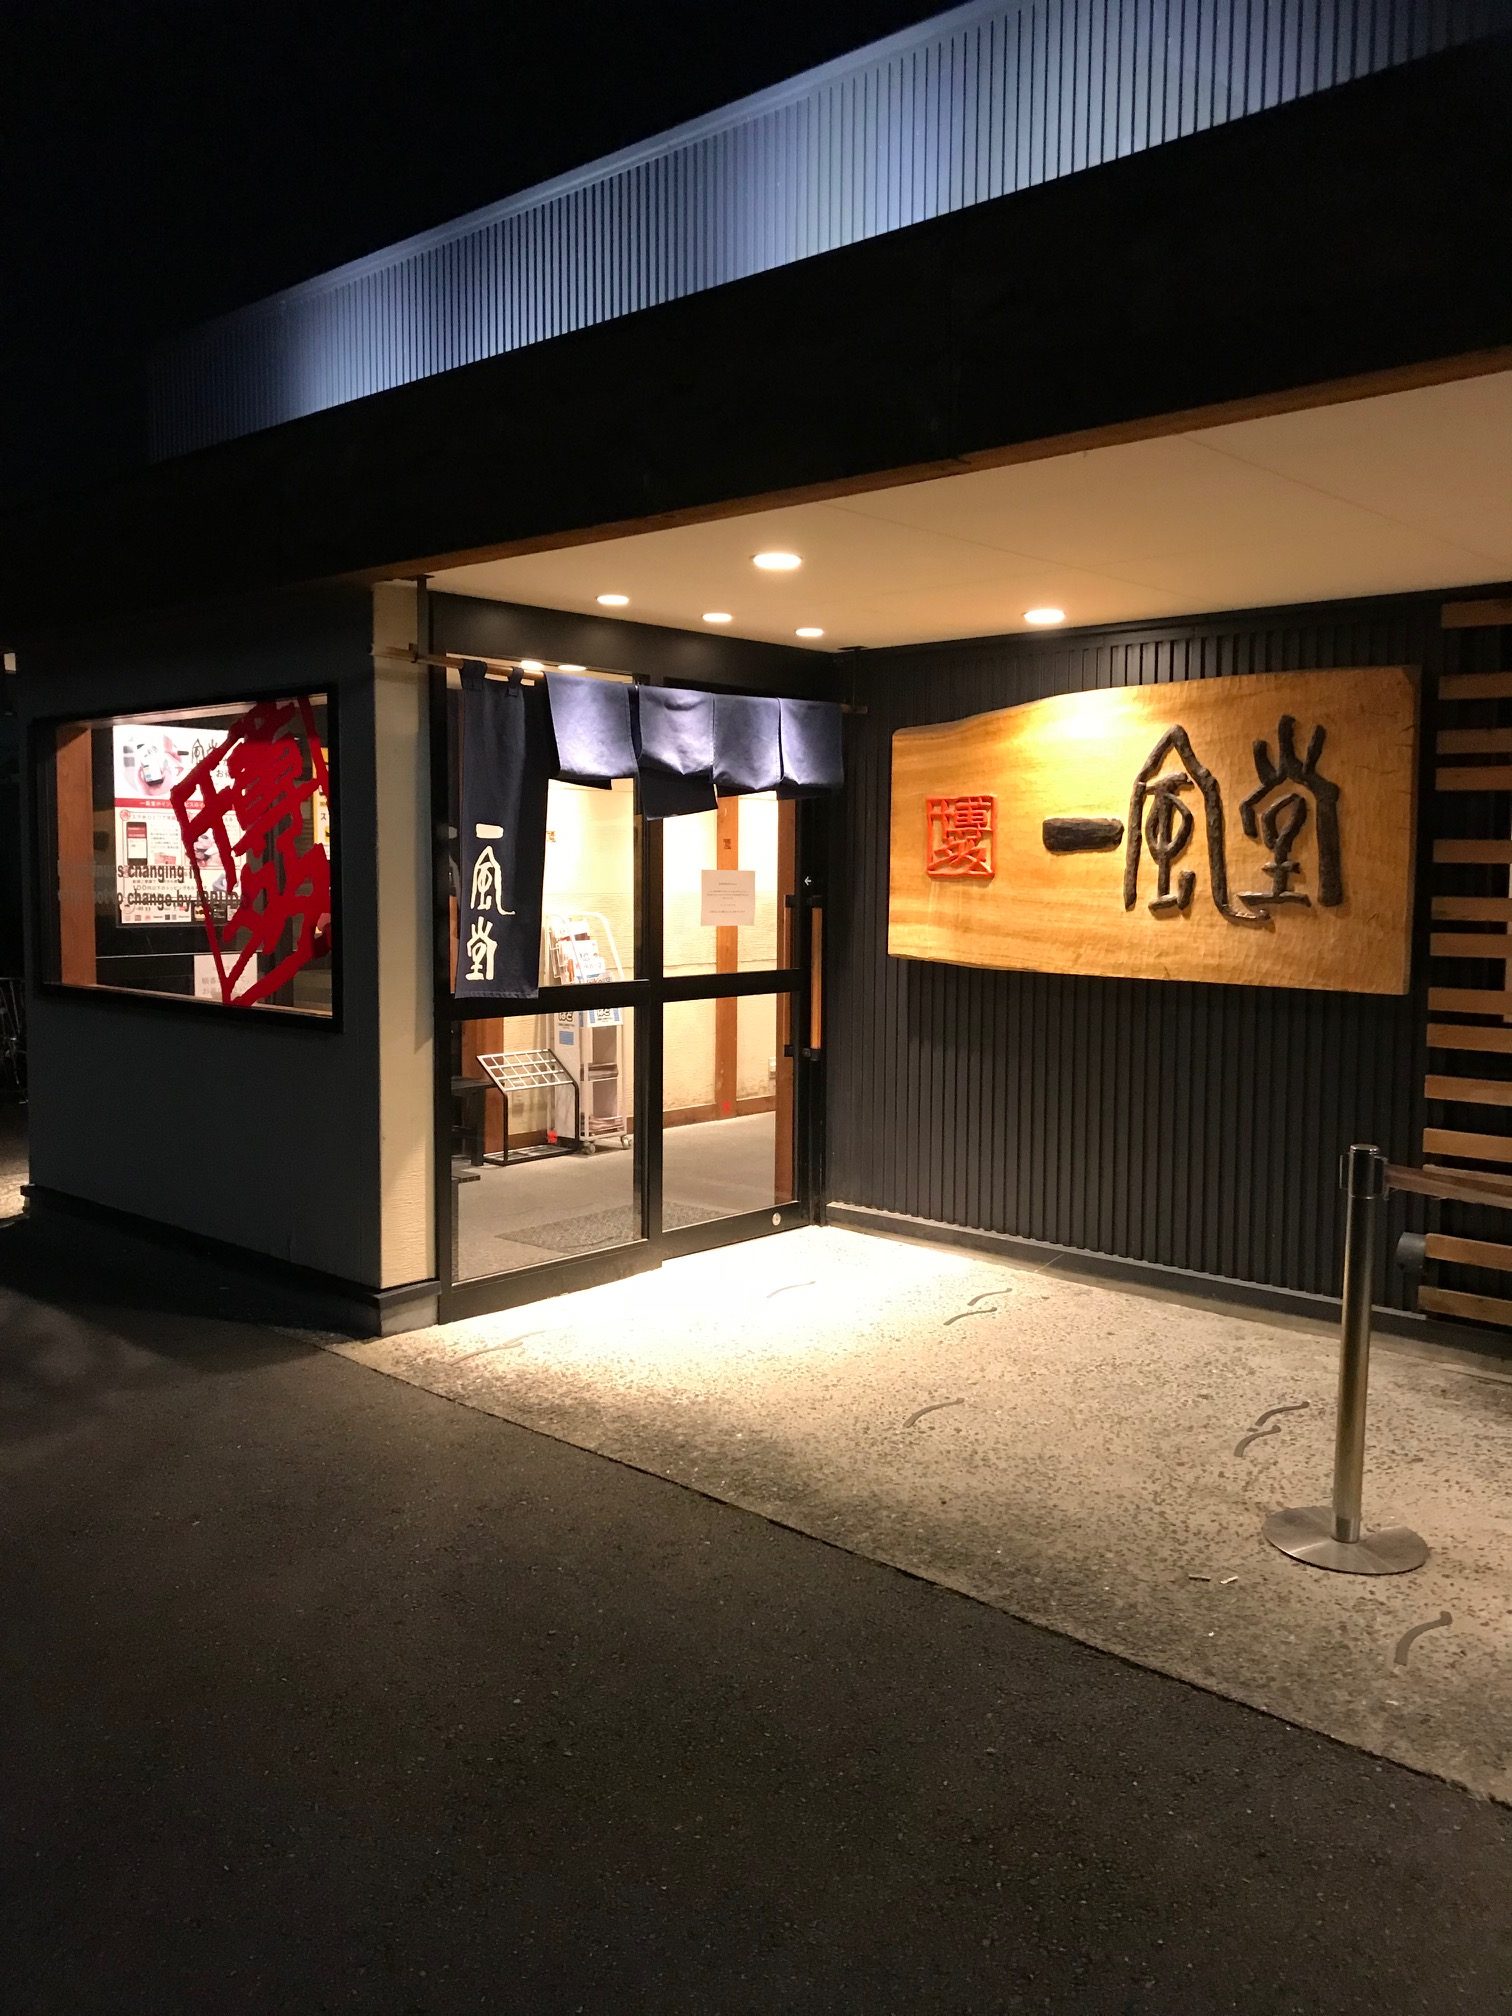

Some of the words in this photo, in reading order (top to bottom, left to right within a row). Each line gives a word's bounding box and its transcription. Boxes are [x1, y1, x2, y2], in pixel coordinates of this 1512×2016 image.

[1042, 714, 1343, 922] 一風堂
[128, 864, 184, 883] changing
[128, 889, 172, 911] change
[177, 889, 191, 912] by
[465, 823, 516, 981] 一風堂
